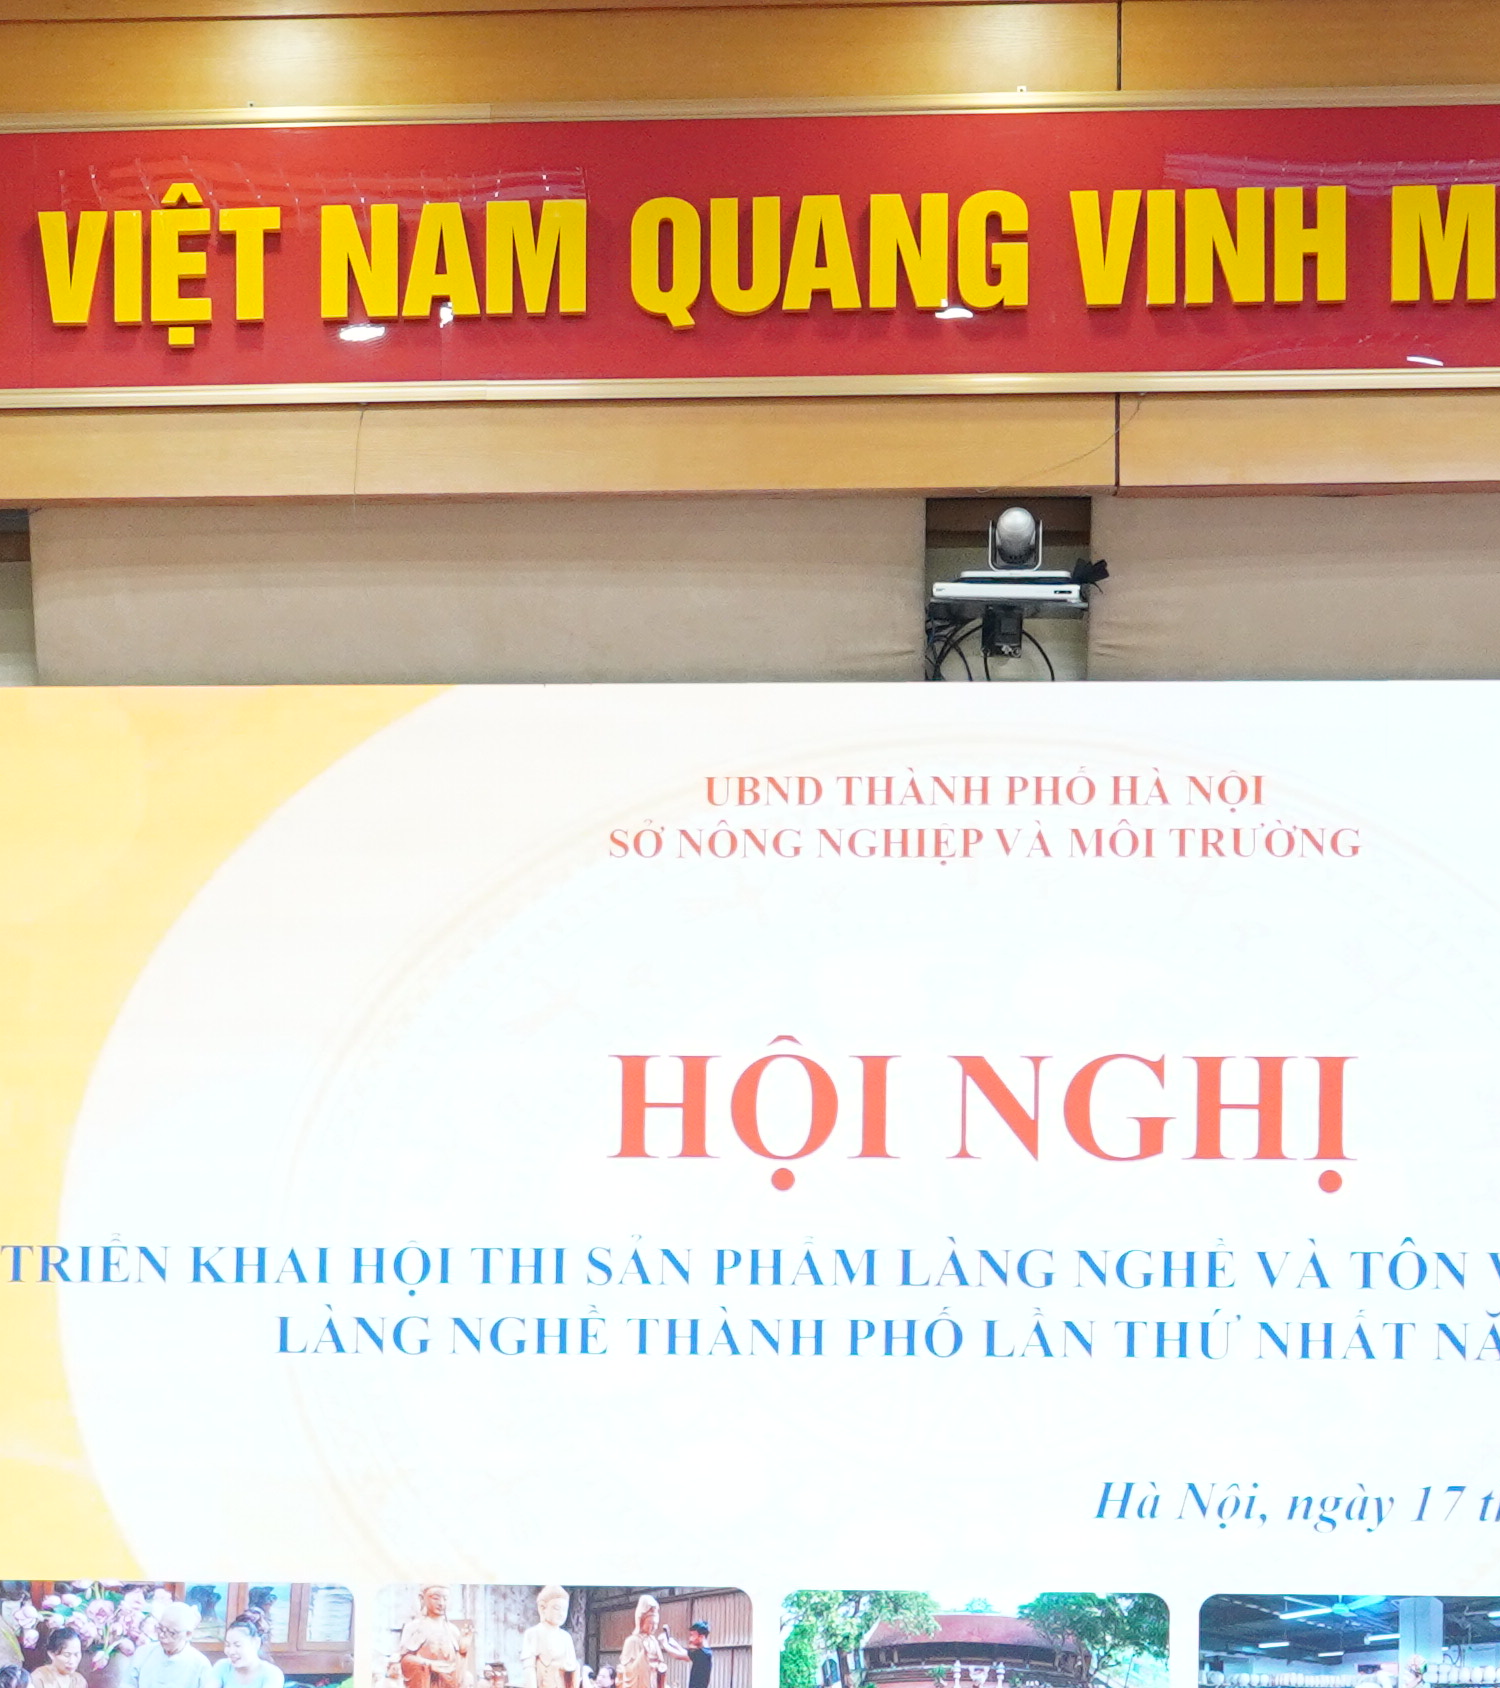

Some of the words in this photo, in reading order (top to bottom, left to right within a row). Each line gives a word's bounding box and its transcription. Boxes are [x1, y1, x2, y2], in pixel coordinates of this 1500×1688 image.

[38, 183, 280, 345] VIỆT
[321, 199, 587, 318] NAM
[631, 190, 1028, 327] QUANG
[1070, 186, 1346, 305] VINH
[705, 776, 823, 806] UBND
[837, 767, 990, 805] THÀNH
[1005, 766, 1097, 806] PHỐ
[1110, 767, 1171, 806] HÀ
[1186, 770, 1266, 813] NỘI
[610, 819, 665, 858] SỞ
[678, 820, 802, 858] NÔNG
[817, 823, 983, 866] NGHIỆP
[995, 820, 1052, 857] VÀ
[1069, 819, 1157, 858] MÔI
[1169, 820, 1362, 858] TRƯỜNG
[607, 1035, 901, 1192] HỘI
[946, 1054, 1358, 1194] NGHỊ
[1, 1234, 169, 1282] TRIỂN
[190, 1246, 329, 1283] KHAI
[352, 1240, 451, 1297] HỘI
[471, 1248, 566, 1284] THI
[587, 1235, 692, 1286] SẢN
[900, 1236, 1056, 1288] LÀNG
[1075, 1238, 1235, 1289] NGHỀ
[1256, 1238, 1331, 1288] VÀ
[1350, 1237, 1468, 1290] TÔN
[276, 1304, 431, 1355] LÀNG
[451, 1304, 608, 1355] NGHỀ
[626, 1306, 825, 1356] THÀNH
[848, 1306, 964, 1358] PHỐ
[984, 1307, 1095, 1357] LẦN
[1114, 1308, 1242, 1360] THỨ
[1257, 1309, 1416, 1360] NHẤT
[1094, 1481, 1160, 1519] Hà
[1176, 1482, 1268, 1529] Nội,
[1287, 1483, 1395, 1533] ngày
[1411, 1486, 1467, 1521] 17
